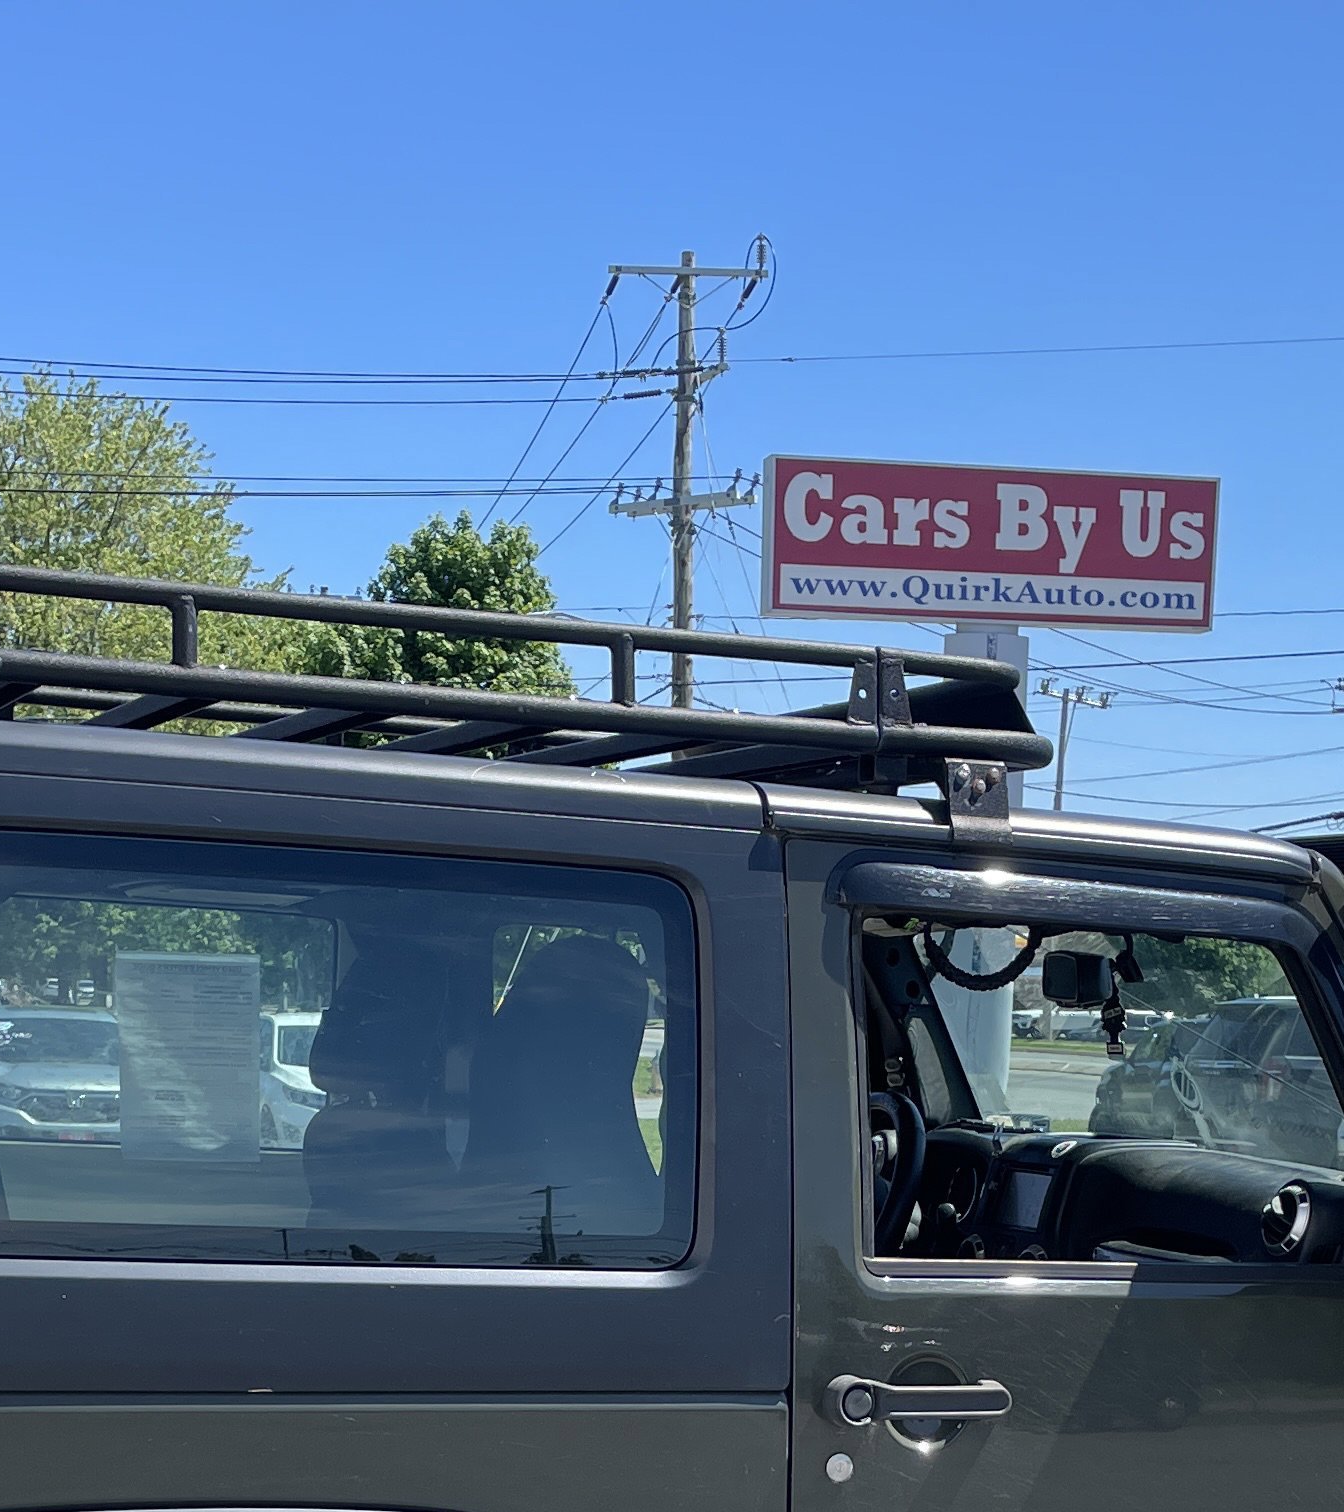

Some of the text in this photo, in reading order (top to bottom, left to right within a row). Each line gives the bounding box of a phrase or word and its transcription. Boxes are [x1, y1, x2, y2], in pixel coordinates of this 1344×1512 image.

[783, 470, 1207, 574] Cars By Us
[789, 574, 1198, 611] www.QuirkAuto.com
